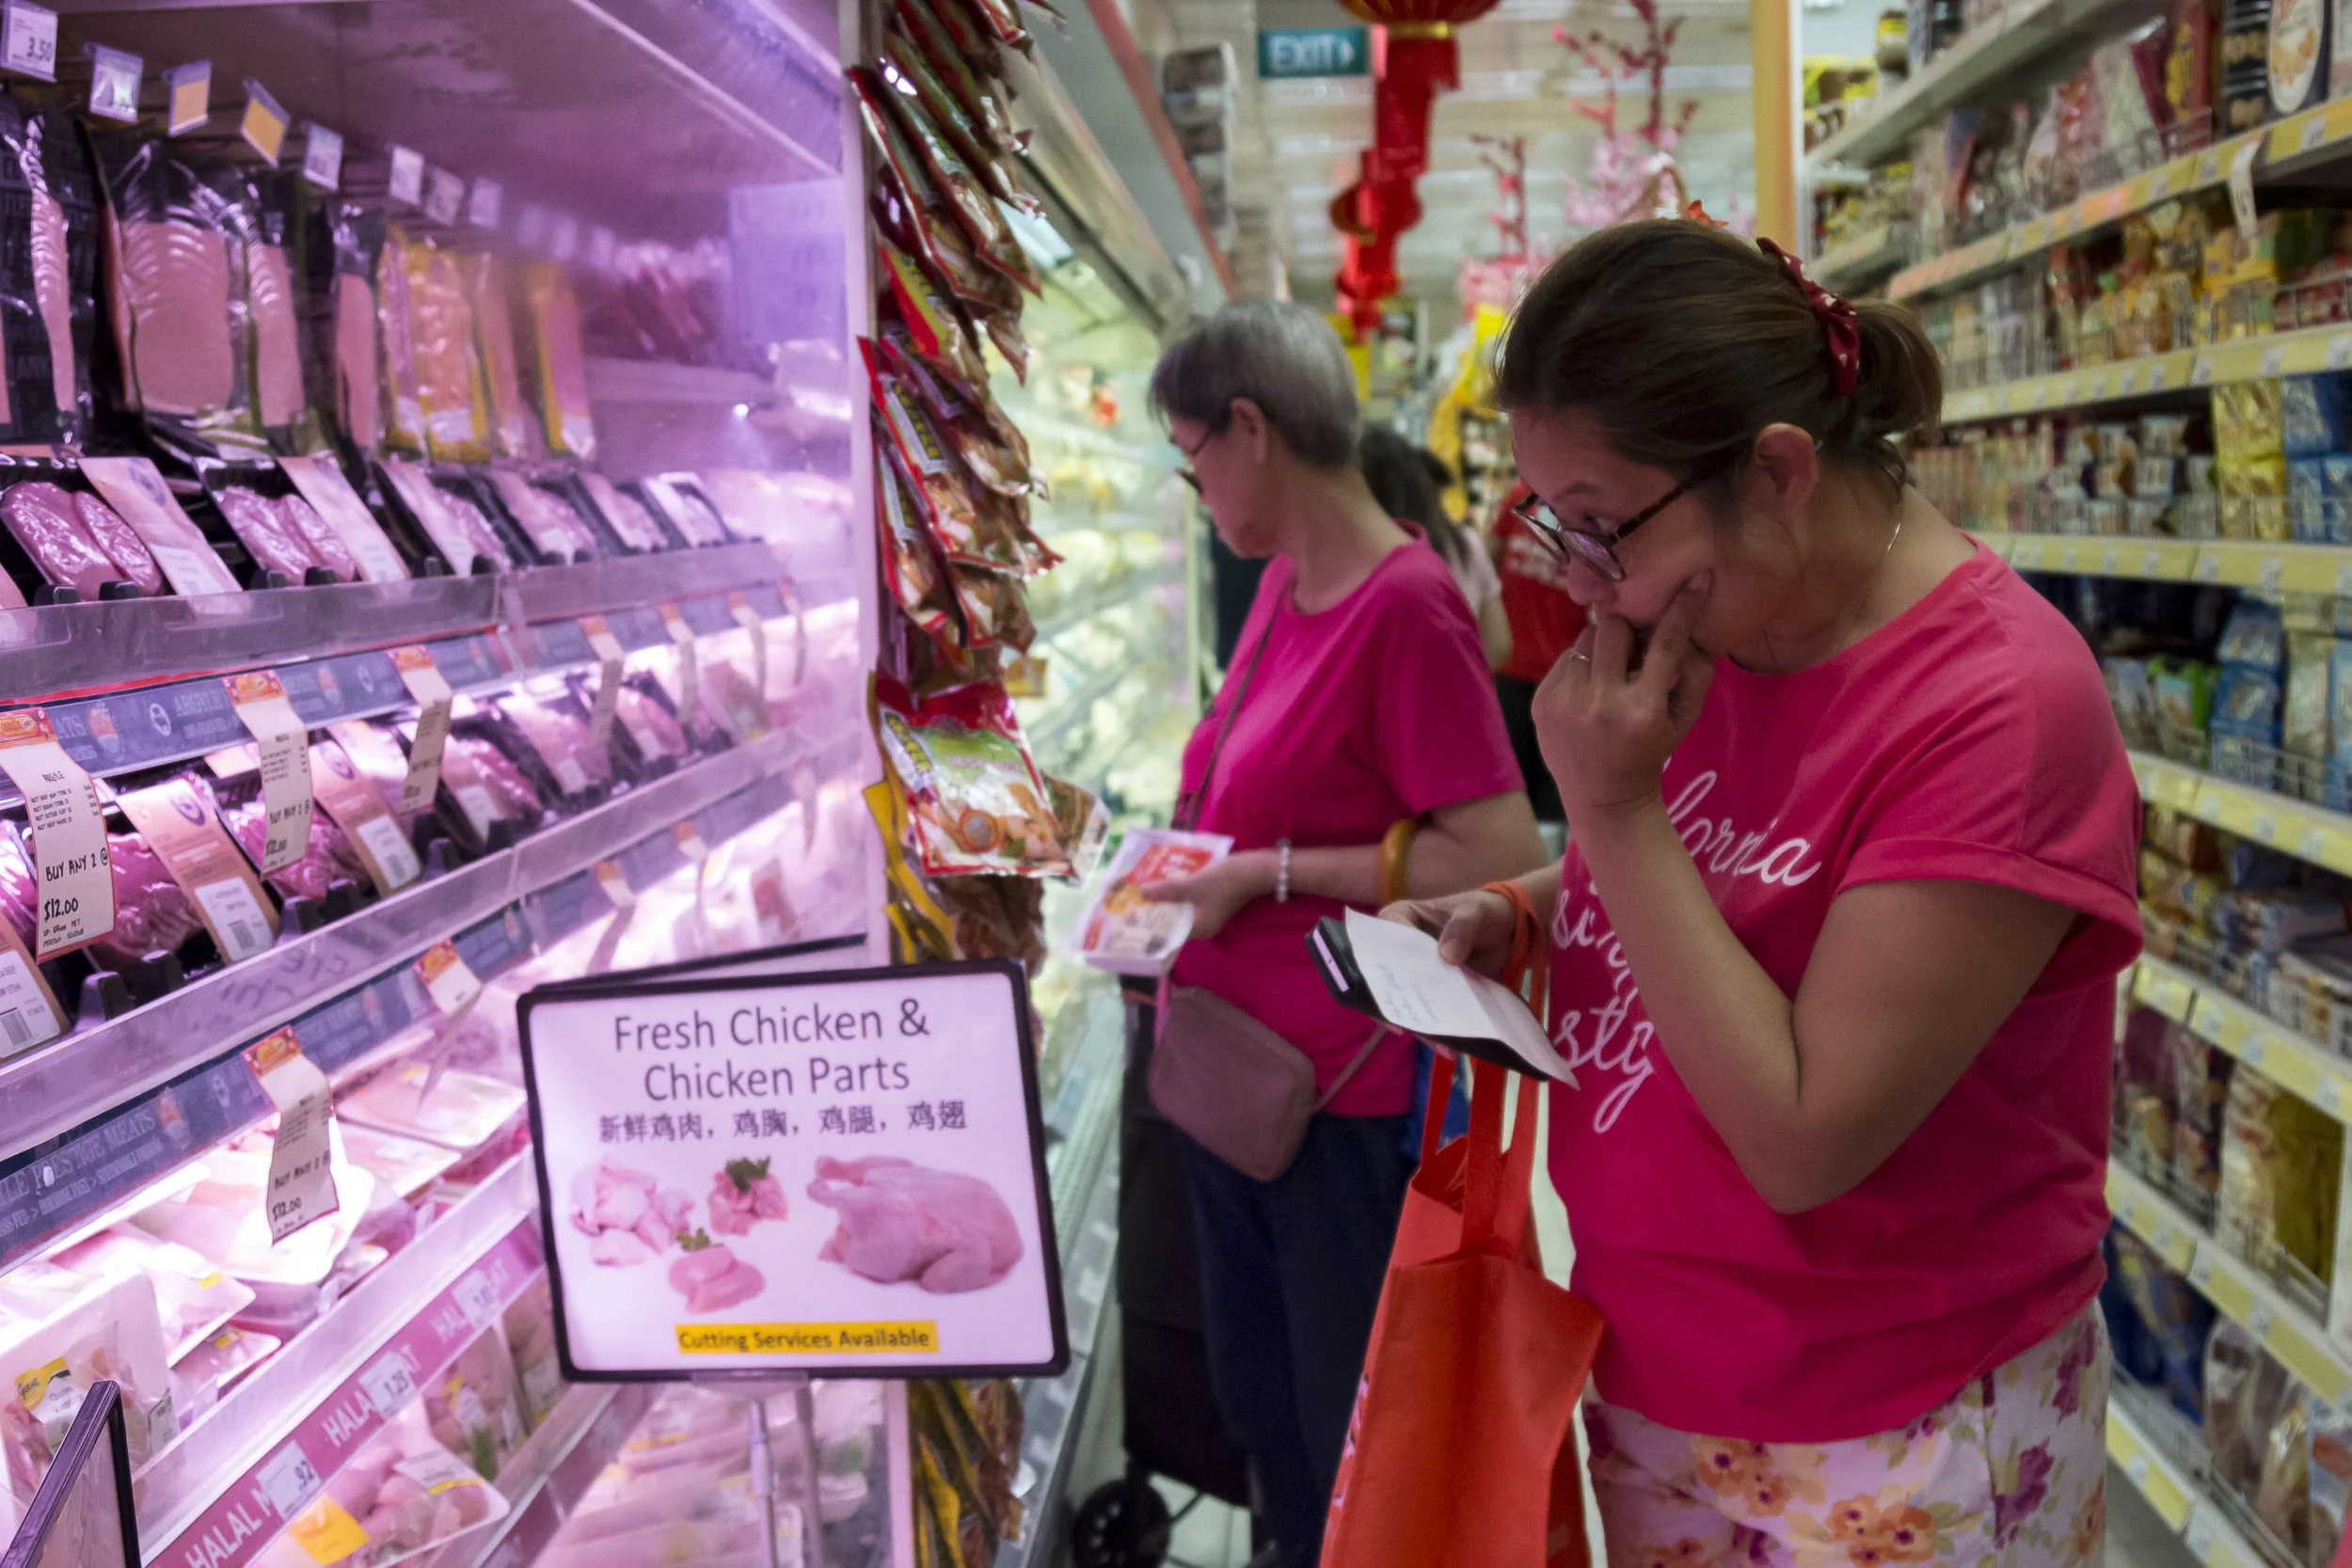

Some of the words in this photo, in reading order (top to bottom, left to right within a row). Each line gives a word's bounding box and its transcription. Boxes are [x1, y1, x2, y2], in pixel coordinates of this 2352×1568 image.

[1268, 36, 1333, 70] EXIT
[46, 863, 65, 882] BUY
[69, 854, 87, 876] ANY
[91, 852, 98, 868] 2
[43, 897, 79, 923] $12.00
[614, 1009, 715, 1052] Fresh
[729, 1003, 882, 1047] Chicken
[898, 998, 930, 1037] &
[644, 1060, 794, 1102] Chicken
[809, 1057, 911, 1094] Parts
[678, 1331, 750, 1353] Cutting
[754, 1330, 833, 1349] Services
[839, 1325, 930, 1348] Available
[322, 1391, 374, 1449] HALA
[184, 1502, 262, 1568] HALAL
